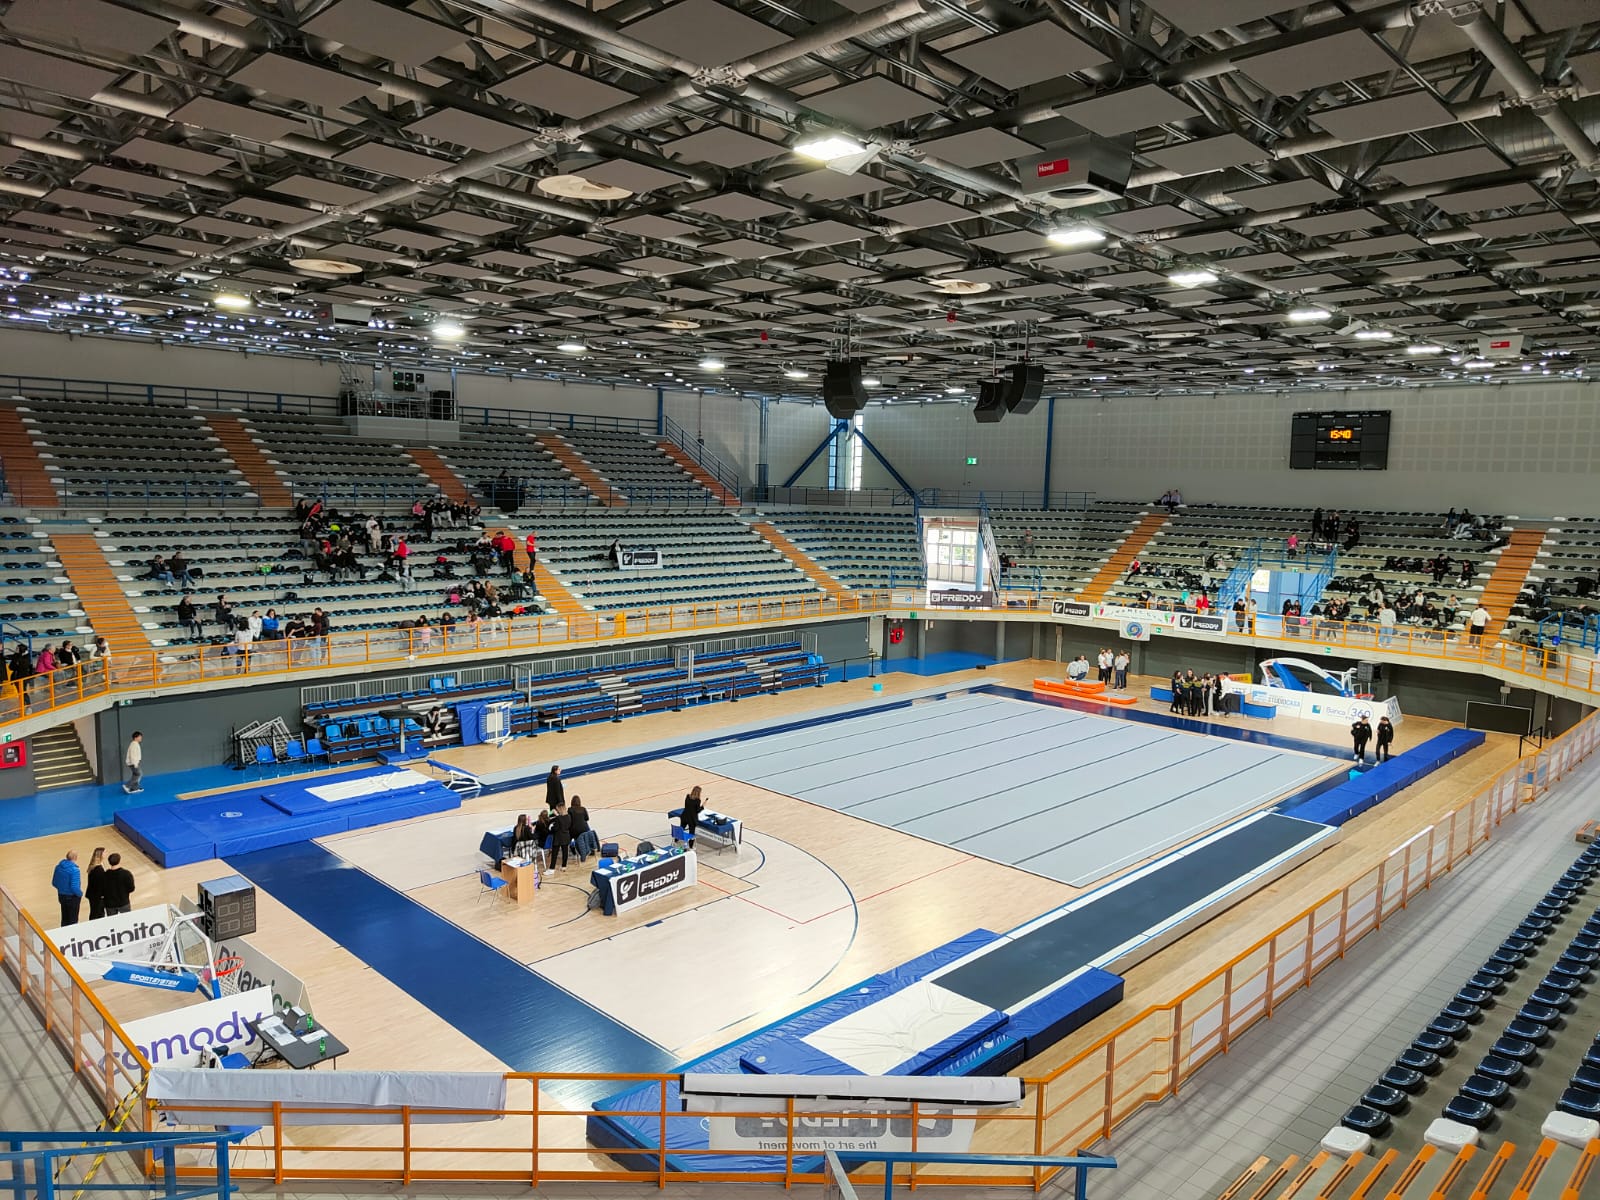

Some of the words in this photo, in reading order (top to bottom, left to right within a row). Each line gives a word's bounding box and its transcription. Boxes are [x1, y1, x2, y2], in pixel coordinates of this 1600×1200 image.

[1330, 429, 1352, 439] 15:40
[940, 594, 983, 602] FREDDY
[1065, 607, 1088, 616] FREDDY
[1193, 621, 1219, 630] FREDDY
[1351, 707, 1371, 718] 360
[640, 869, 680, 892] FREDDY
[60, 922, 165, 957] rincipito
